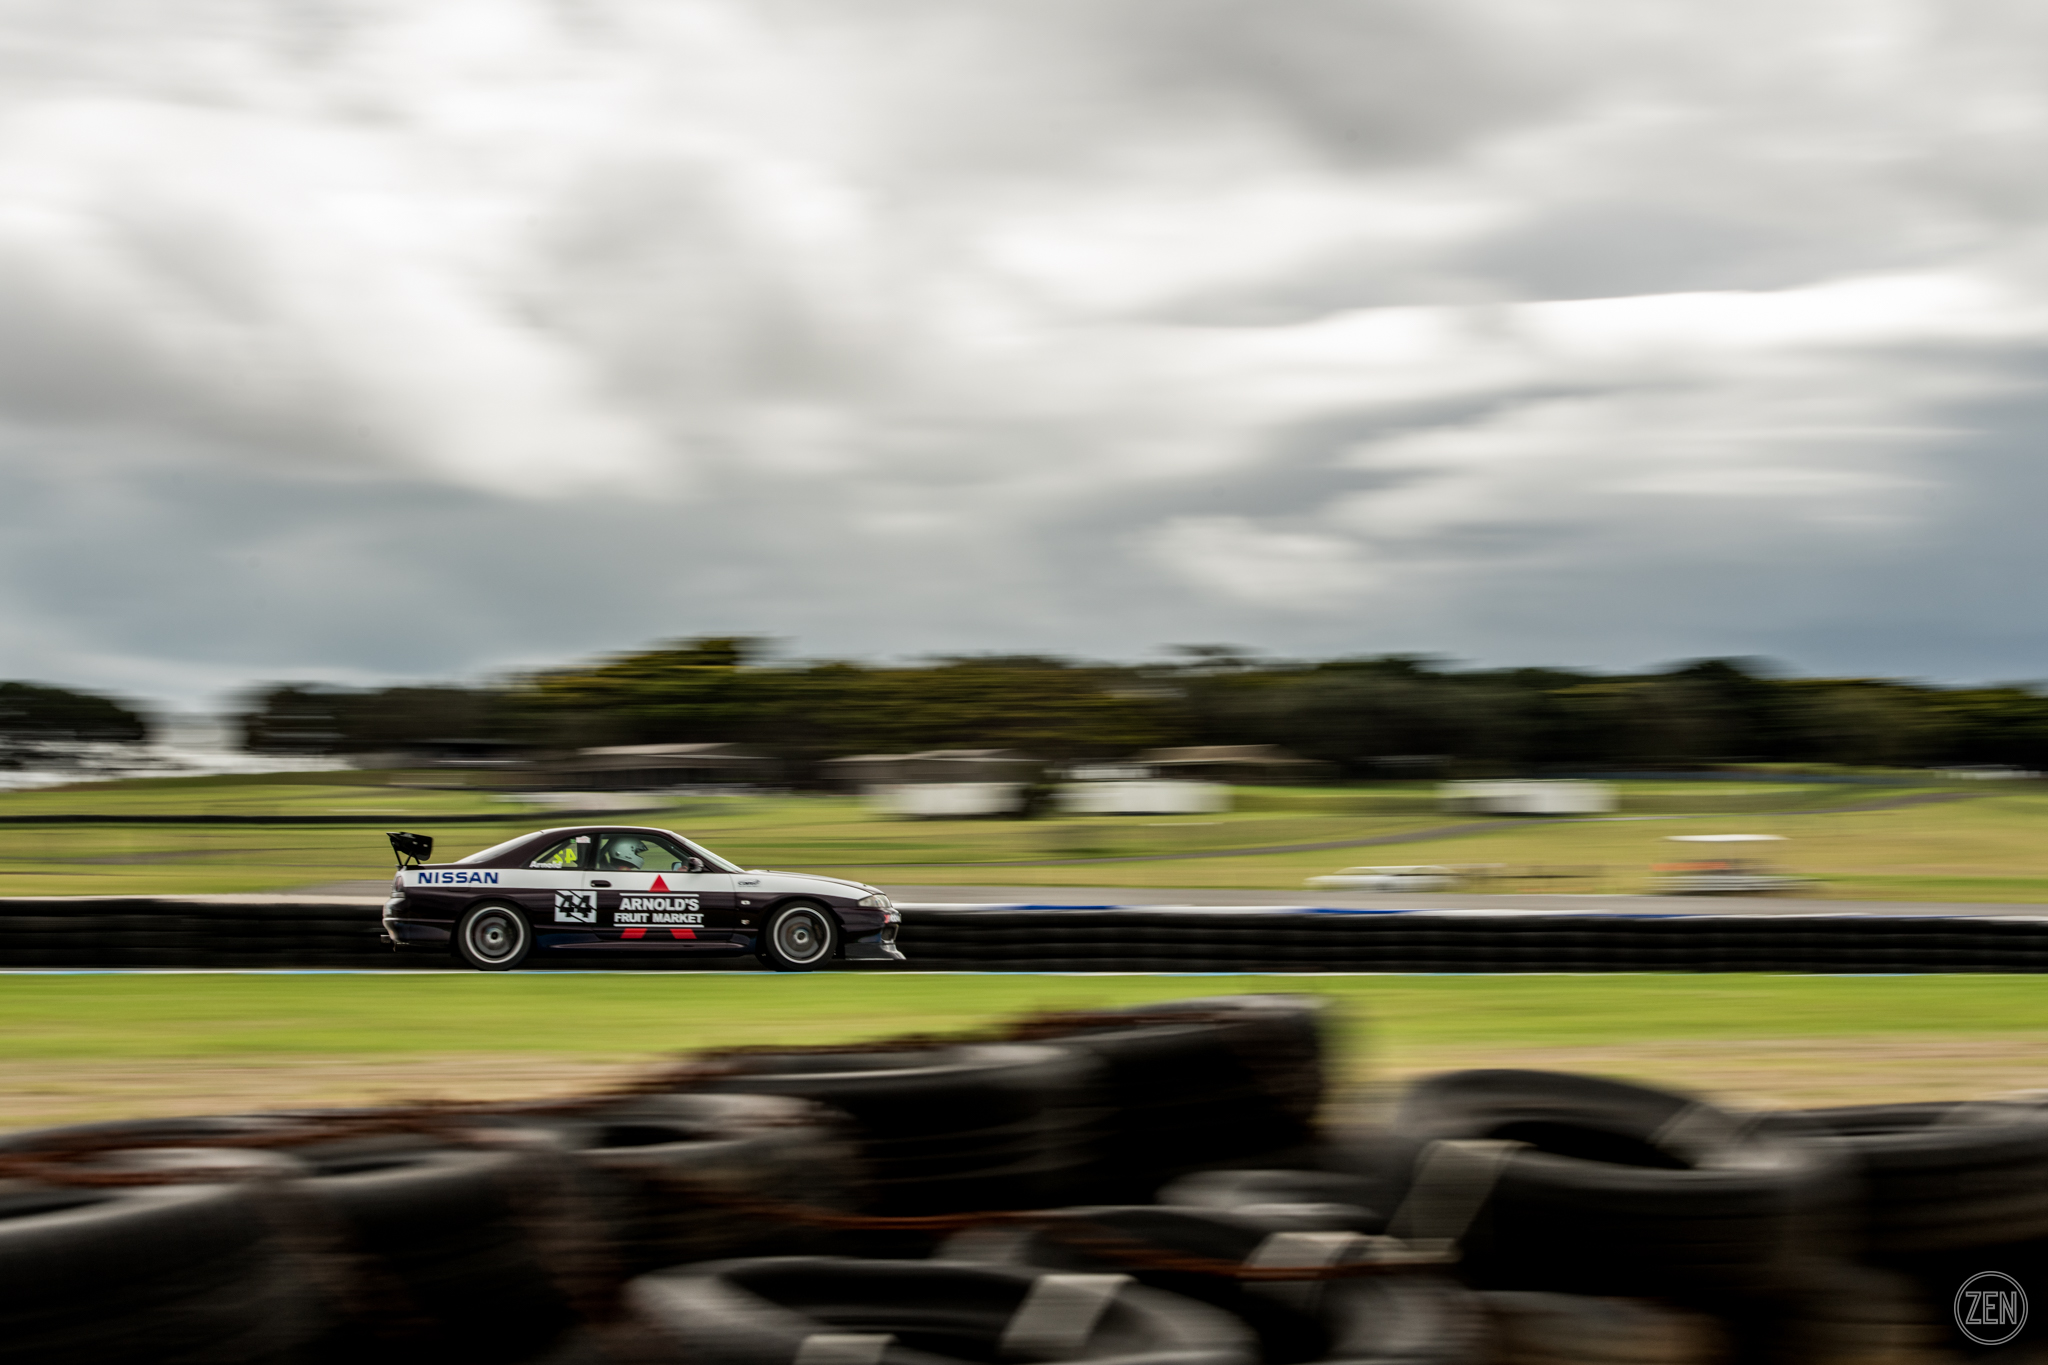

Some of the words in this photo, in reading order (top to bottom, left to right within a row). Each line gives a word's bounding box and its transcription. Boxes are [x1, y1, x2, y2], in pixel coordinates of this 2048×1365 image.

[529, 860, 563, 868] Arnold
[418, 872, 499, 884] NISSAN
[559, 895, 592, 918] 44
[619, 897, 700, 911] ARNOLD'S
[613, 912, 650, 922] FRUIT
[652, 913, 705, 923] MARKET
